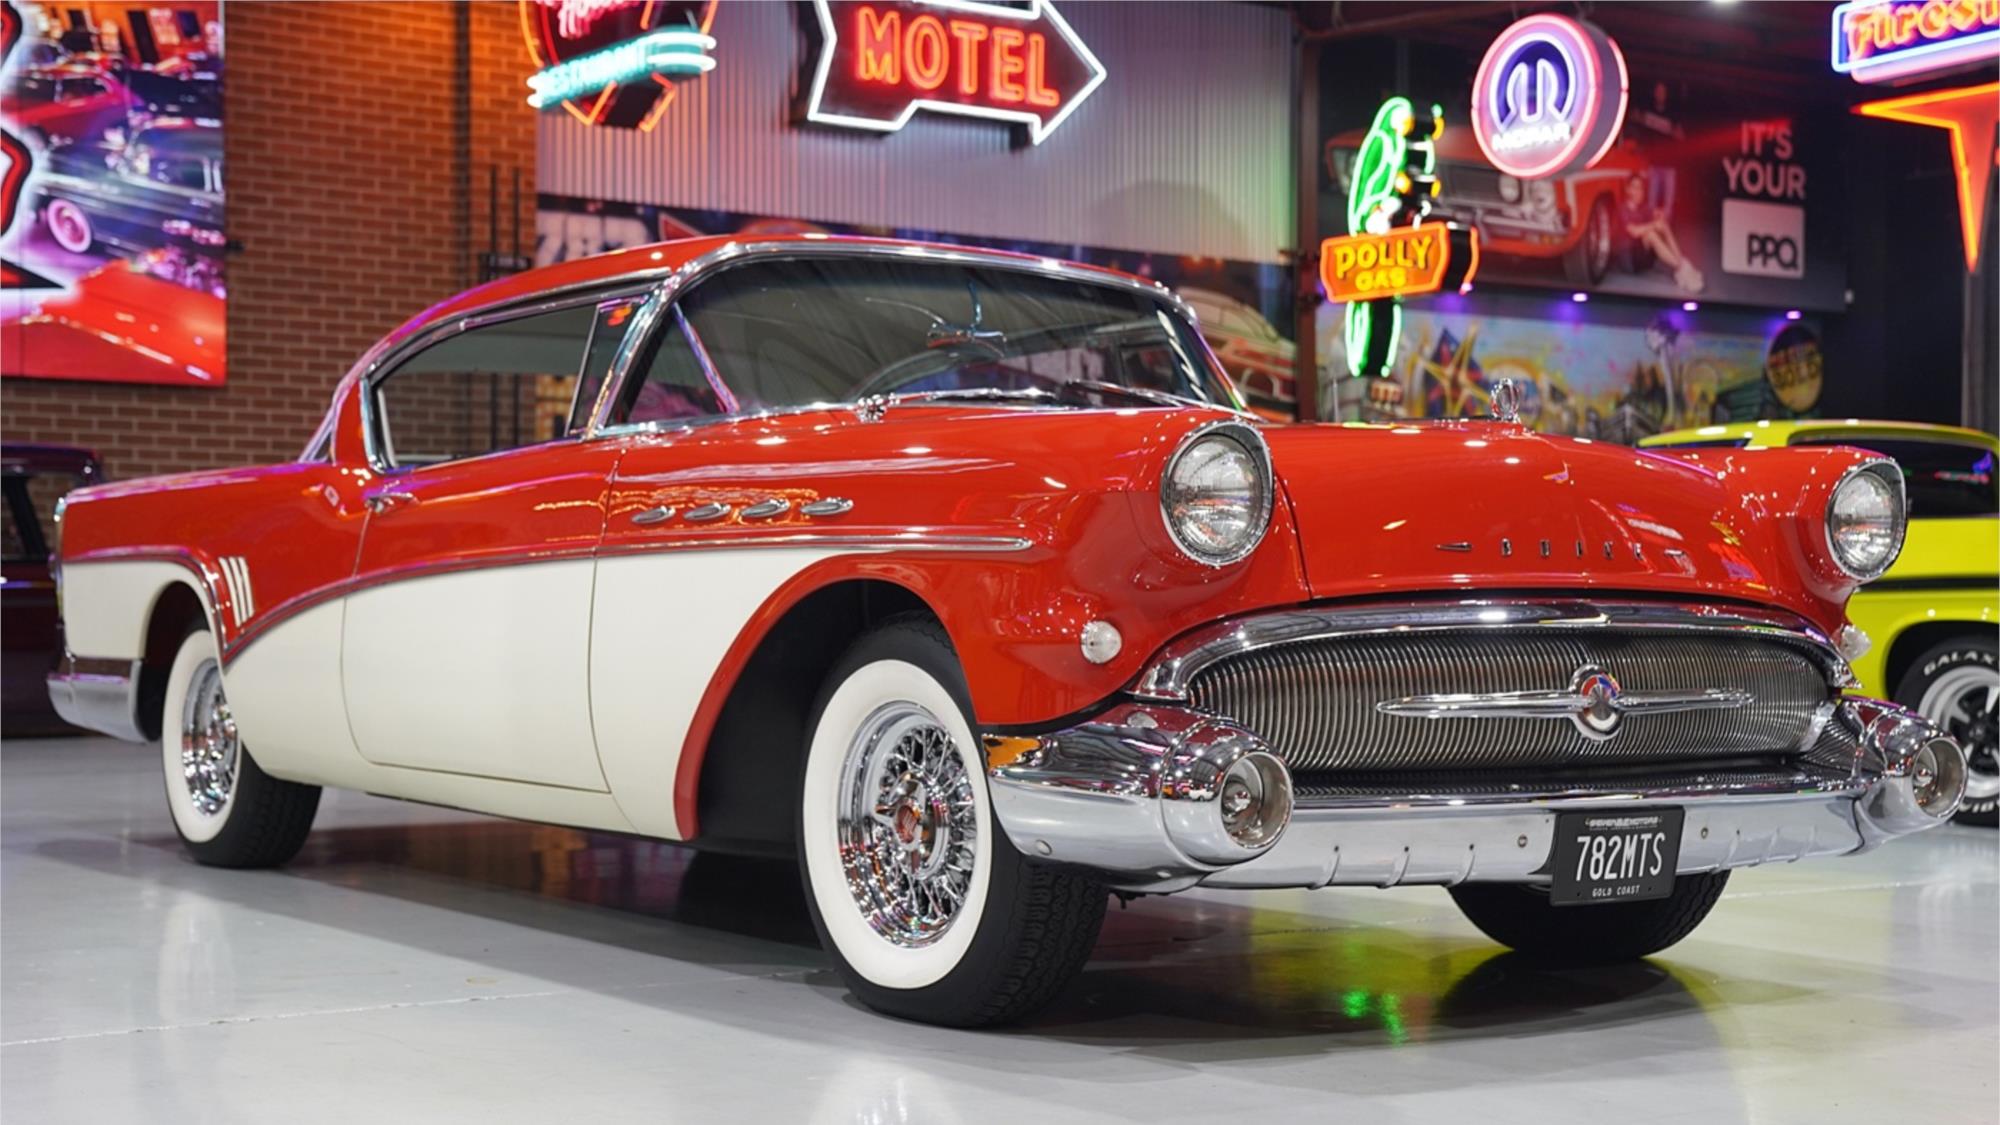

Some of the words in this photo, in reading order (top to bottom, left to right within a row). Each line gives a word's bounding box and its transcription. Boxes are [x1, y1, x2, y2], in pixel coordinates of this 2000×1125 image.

[857, 6, 1060, 107] MOTEL
[1492, 122, 1571, 150] MOPAR
[1741, 121, 1794, 160] IT'S
[1722, 157, 1806, 199] YOUR
[1334, 236, 1432, 279] POLLY
[1747, 233, 1799, 271] PPQ
[1355, 267, 1407, 291] GAS
[1576, 832, 1665, 881] 782MTS
[1592, 887, 1613, 898] GOLD
[1616, 885, 1641, 896] COAST
